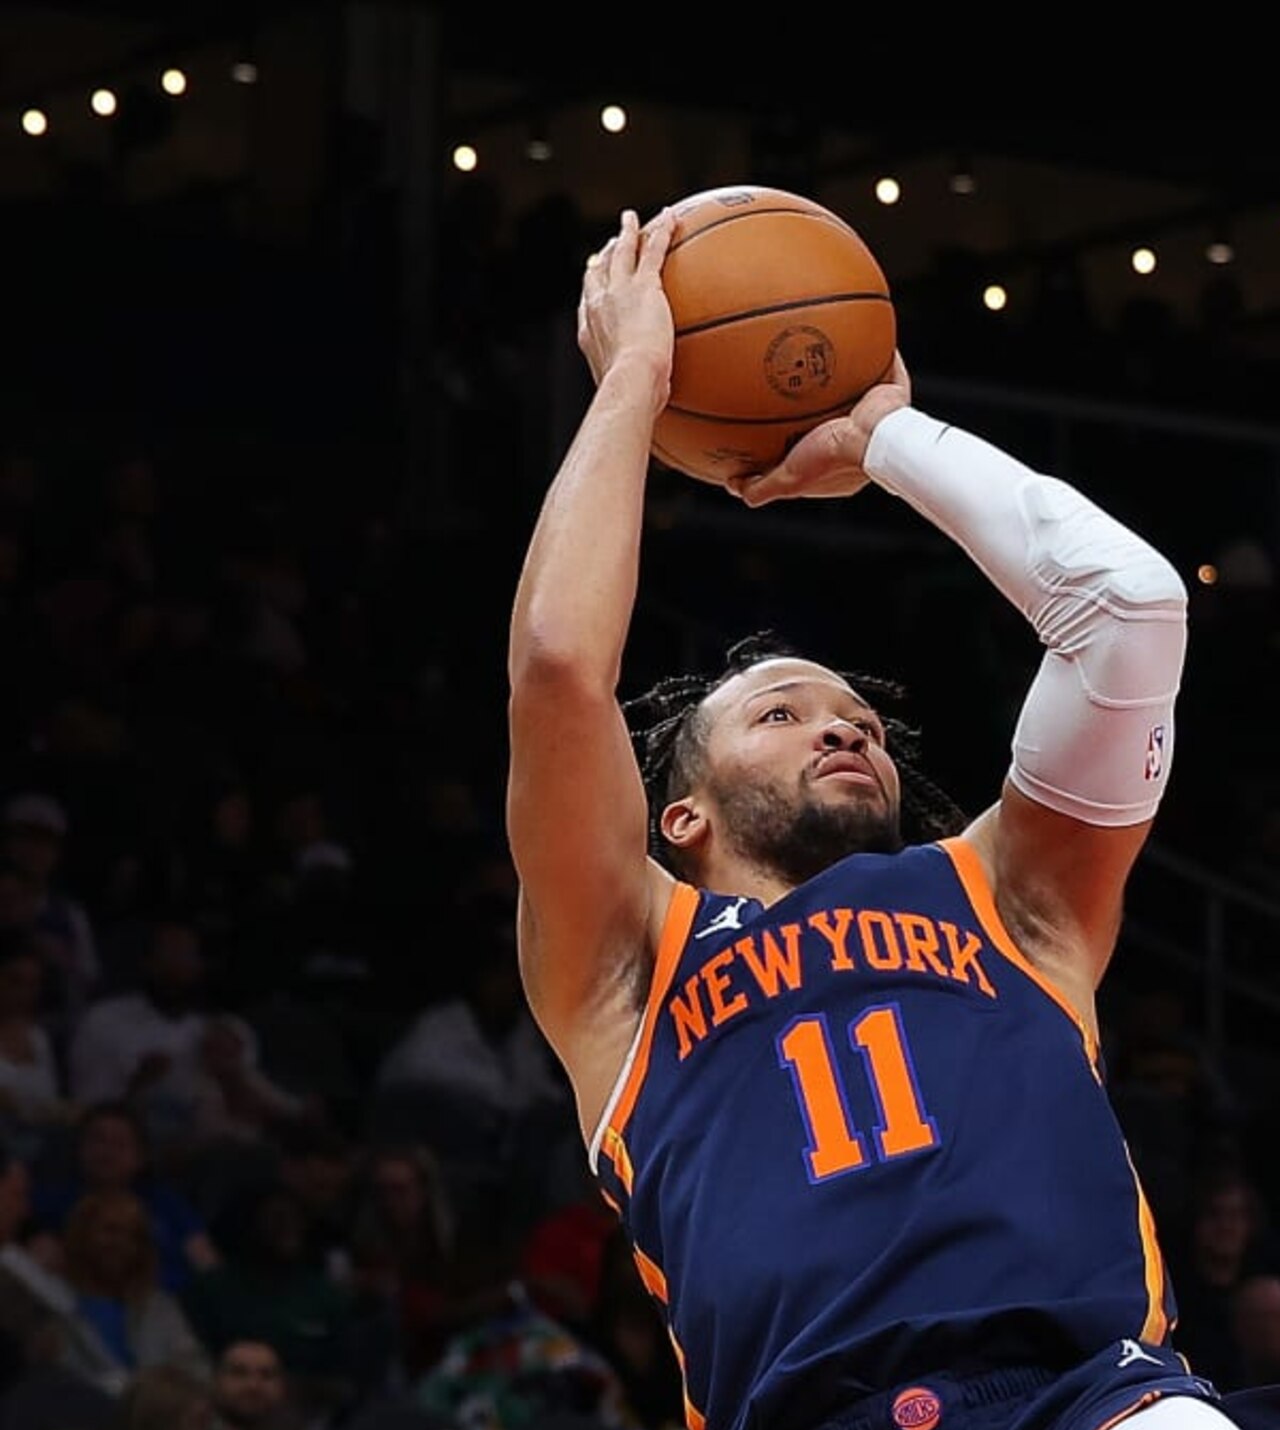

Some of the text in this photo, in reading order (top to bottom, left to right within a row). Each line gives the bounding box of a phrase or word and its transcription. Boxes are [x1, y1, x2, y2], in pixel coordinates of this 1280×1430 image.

[668, 908, 999, 1060] NEW YORK
[777, 1002, 943, 1184] 11
